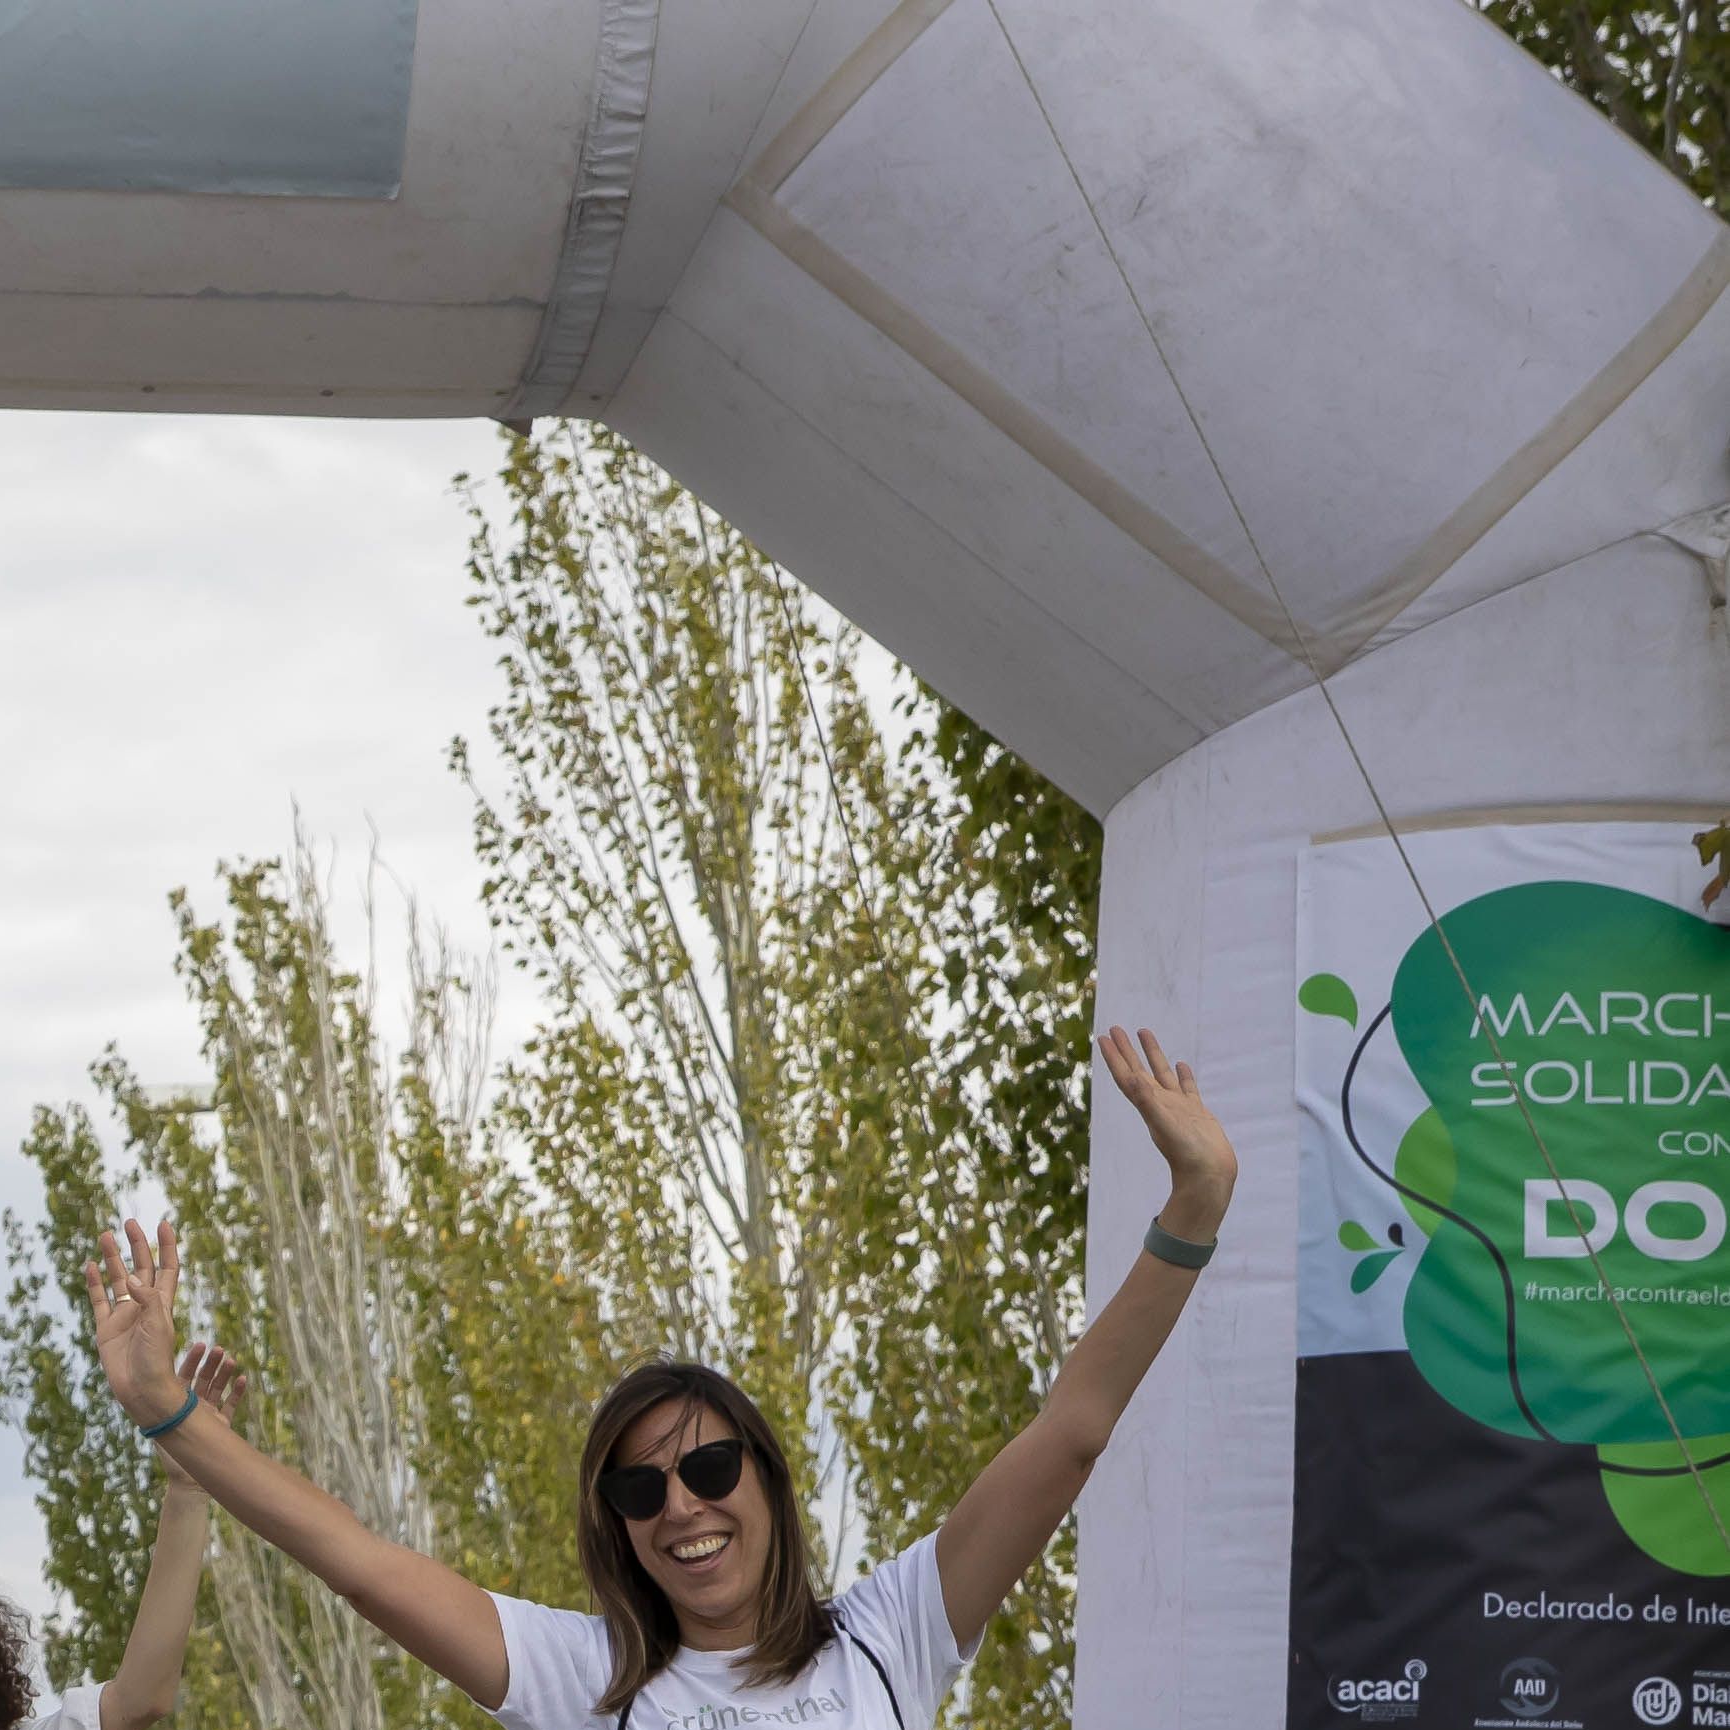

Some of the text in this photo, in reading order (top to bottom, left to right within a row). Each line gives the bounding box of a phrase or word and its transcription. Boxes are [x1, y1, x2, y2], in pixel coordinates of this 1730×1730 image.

[1471, 1060, 1730, 1106] SOLIDA
[1525, 1178, 1727, 1262] DO
[1484, 1591, 1634, 1621] Declarado
[1643, 1594, 1677, 1622] de
[1338, 1664, 1426, 1701] acaci
[1693, 1683, 1730, 1705] Dia
[1693, 1706, 1730, 1726] Ma
